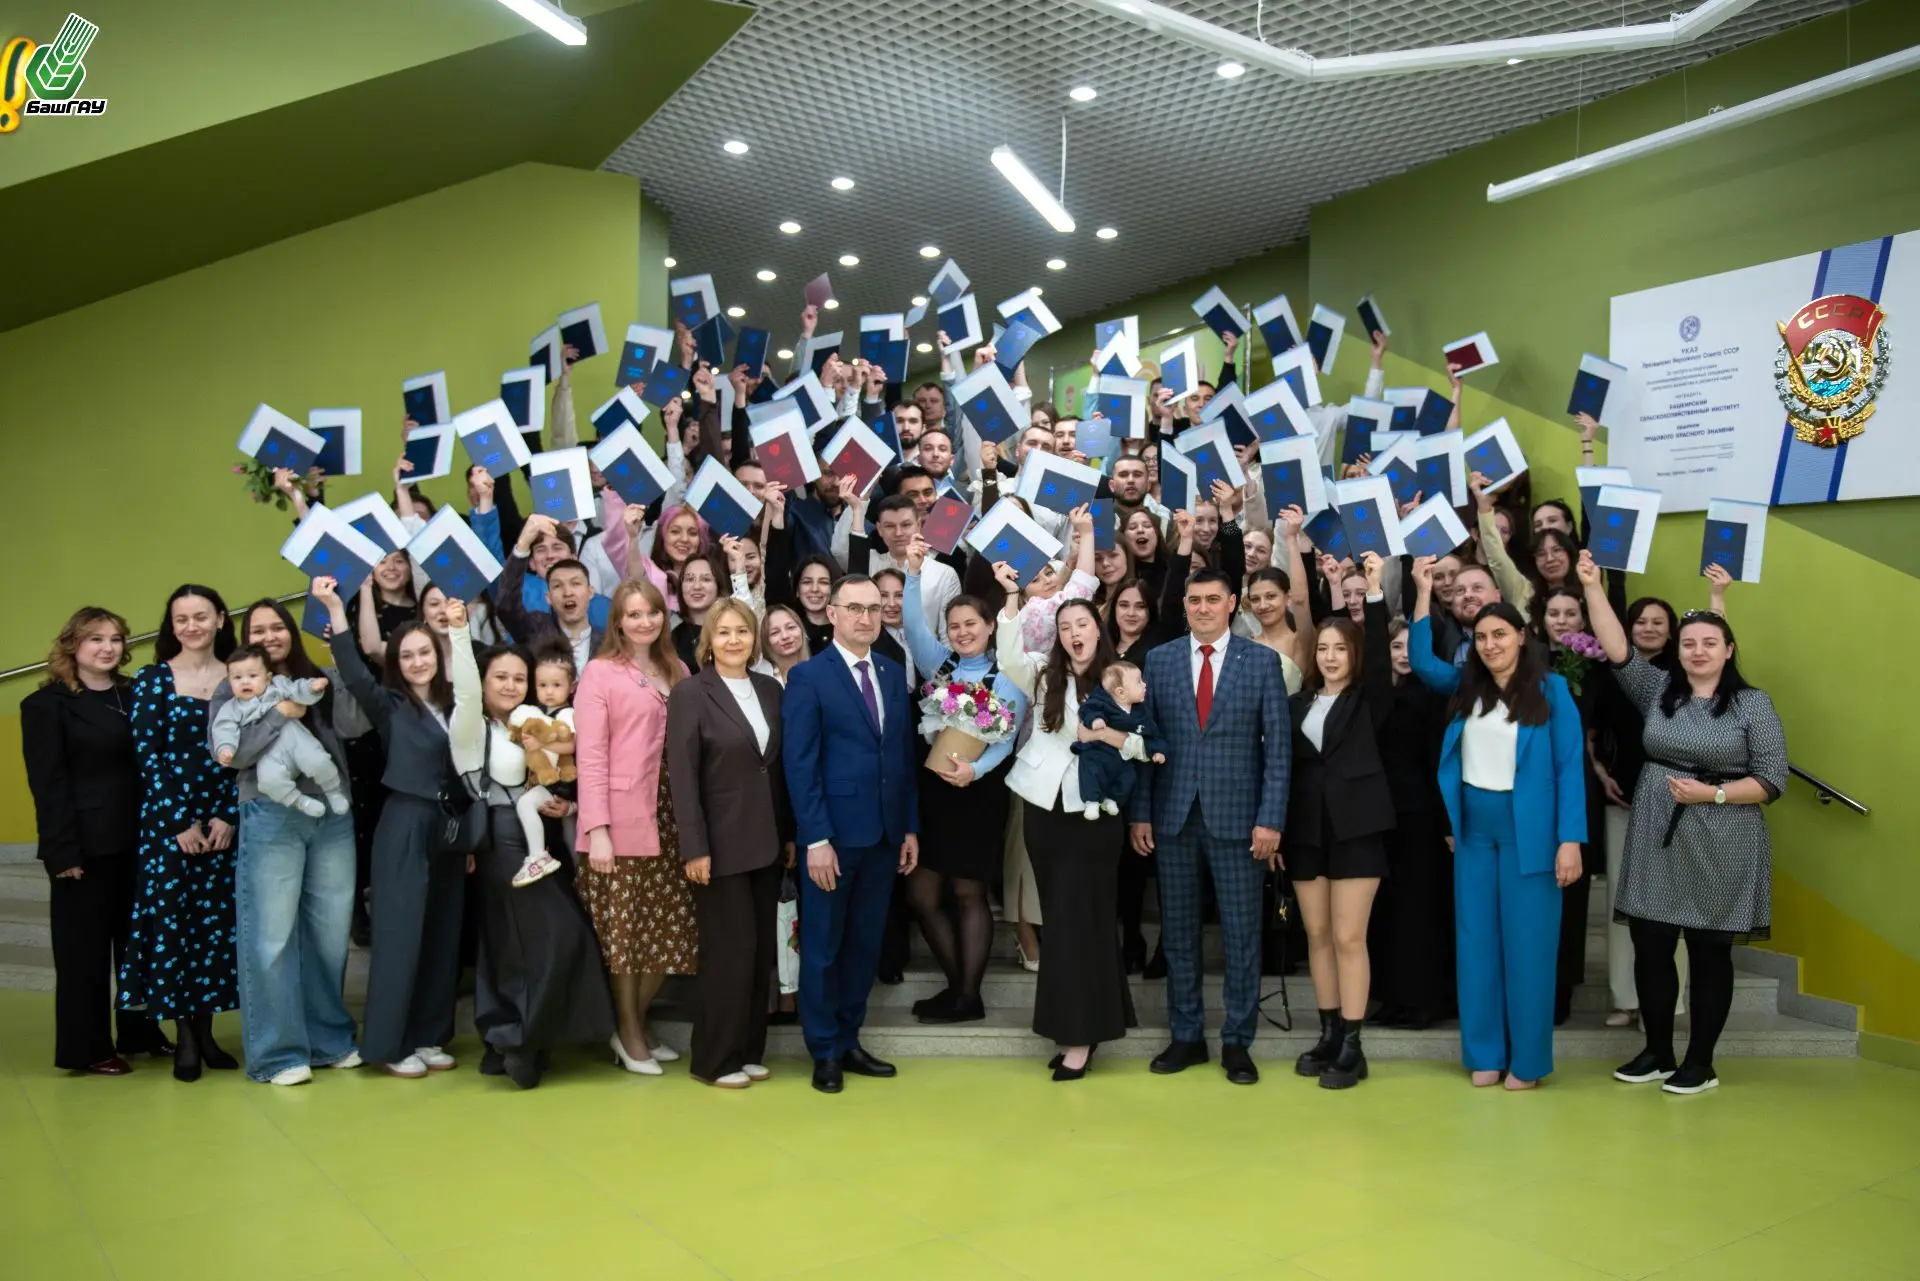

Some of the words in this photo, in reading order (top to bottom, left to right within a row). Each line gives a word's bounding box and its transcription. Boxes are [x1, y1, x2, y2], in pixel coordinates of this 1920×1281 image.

[1797, 303, 1864, 329] СССР
[1681, 346, 1698, 354] УКАЗ
[1723, 346, 1740, 355] СССР
[1669, 399, 1708, 410] БАШКИРСКИЙ
[1711, 403, 1740, 413] ИНСТИТУТ
[1675, 430, 1706, 439] КРАСНОГО
[1707, 426, 1735, 435] ЗНАМЕНИ
